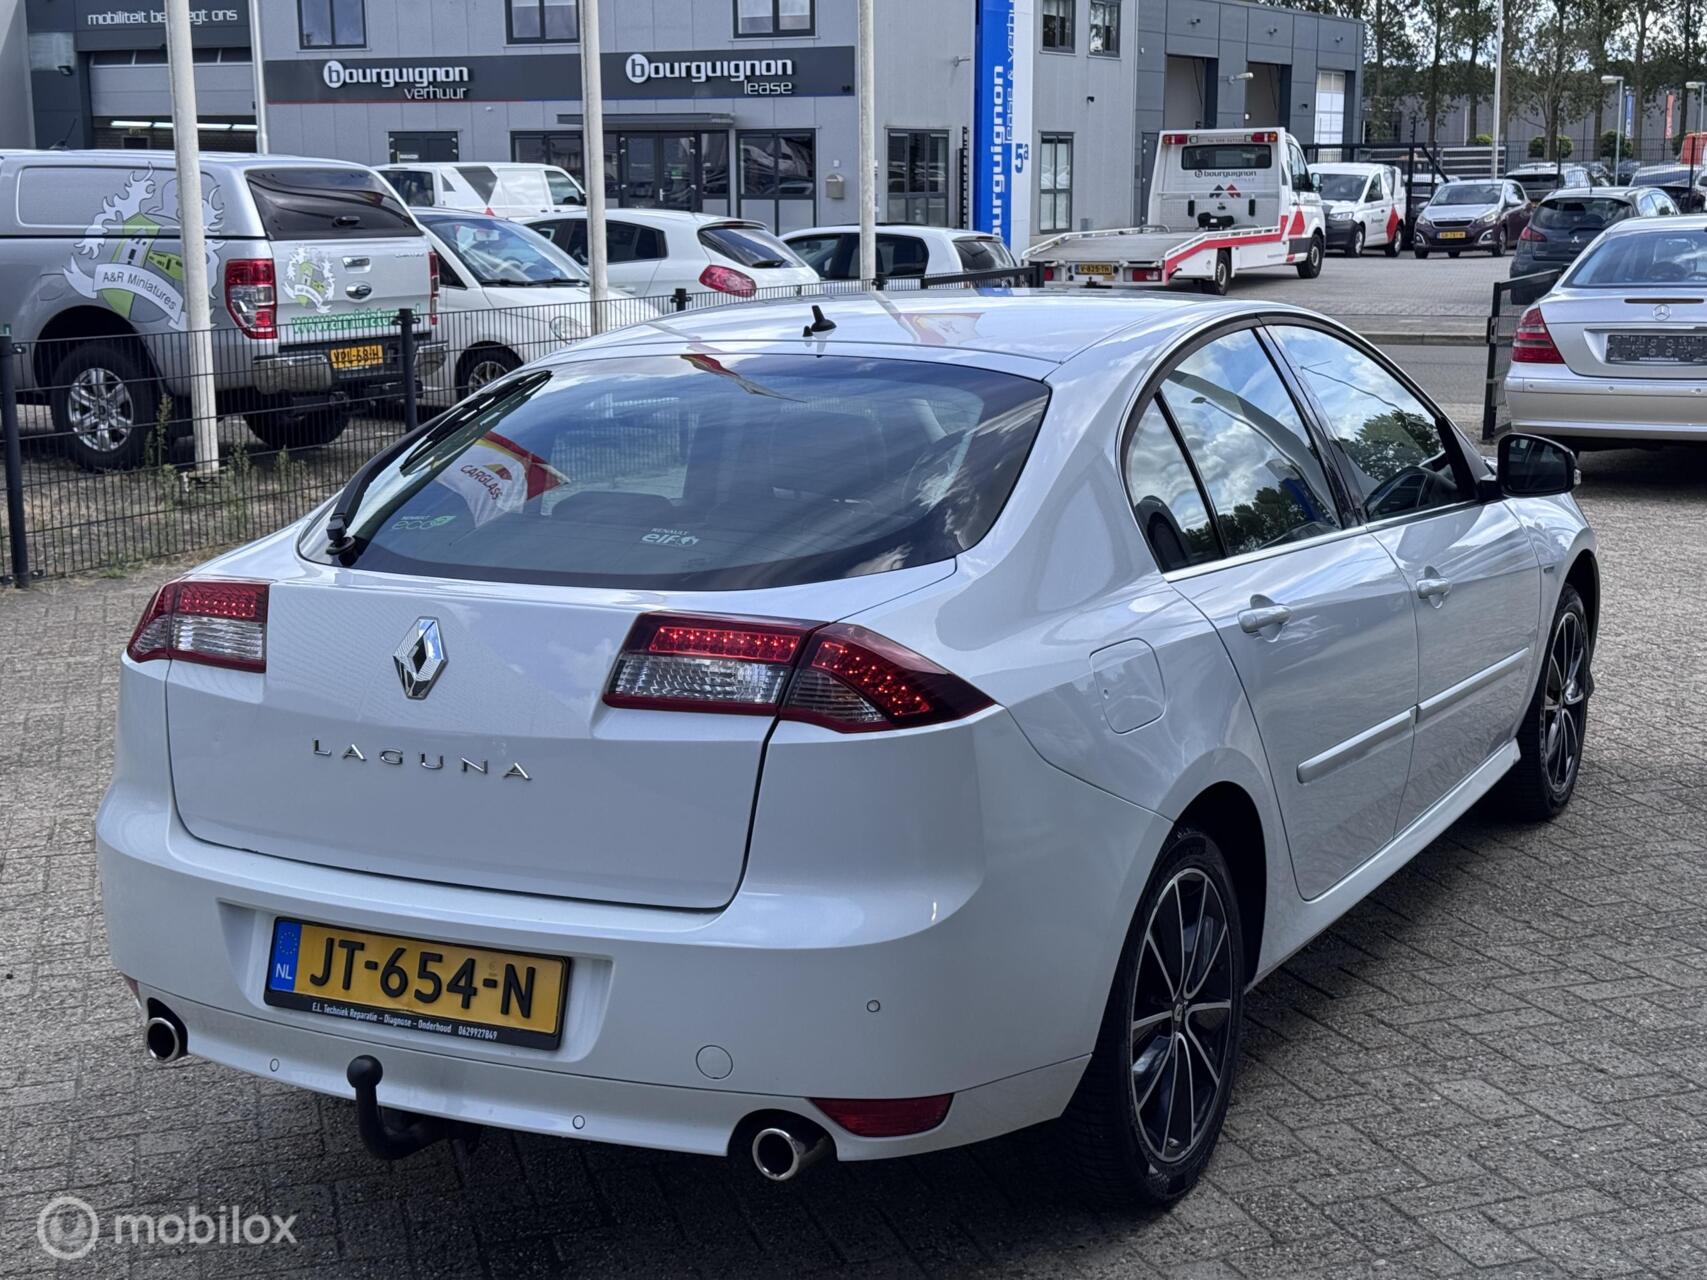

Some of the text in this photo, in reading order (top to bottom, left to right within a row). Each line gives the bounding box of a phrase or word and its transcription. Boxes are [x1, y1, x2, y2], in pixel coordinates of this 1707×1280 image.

[87, 10, 148, 25] mobiliteit
[211, 9, 238, 22] ons
[323, 60, 469, 88] bourguignon
[625, 54, 793, 83] bourguignon
[404, 85, 467, 99] verhuur
[744, 80, 793, 94] lease
[102, 271, 177, 310] A&R Miniatures
[460, 464, 503, 500] CARGLASS
[641, 533, 680, 544] elf
[312, 738, 532, 781] LAGUNA
[275, 963, 293, 980] NL
[309, 937, 537, 1019] JT-654-N
[323, 1004, 349, 1017] Techniek
[349, 1008, 378, 1021] Reparatie
[383, 1014, 412, 1027] Diagnose
[418, 1020, 452, 1033] Onderhoud
